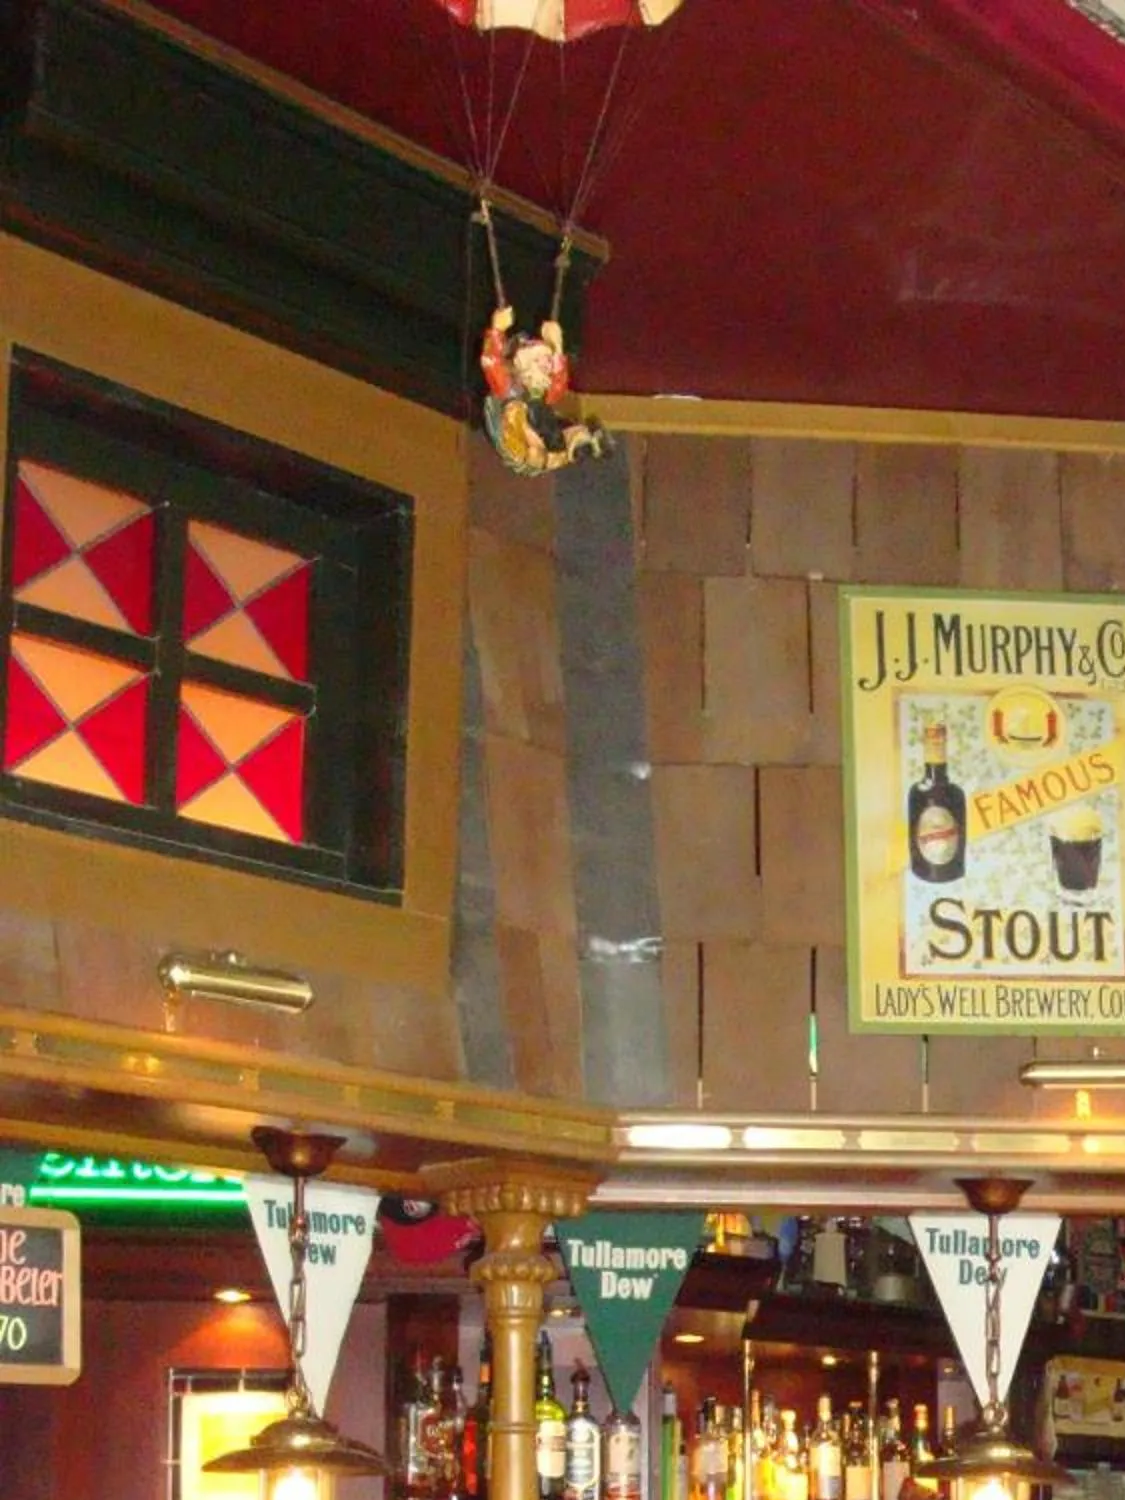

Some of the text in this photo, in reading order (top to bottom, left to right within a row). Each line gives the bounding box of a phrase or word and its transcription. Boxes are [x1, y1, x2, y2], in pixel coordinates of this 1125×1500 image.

[933, 612, 1077, 677] MURPHY
[973, 752, 1116, 830] FAMOUS
[929, 897, 1114, 962] STOUT
[875, 983, 934, 1017] LADY'S
[937, 984, 991, 1018] WELL
[263, 1199, 367, 1235] Tulmore
[567, 1239, 688, 1271] Tullamore
[925, 1227, 1041, 1259] Tullaore
[601, 1270, 653, 1300] Dew
